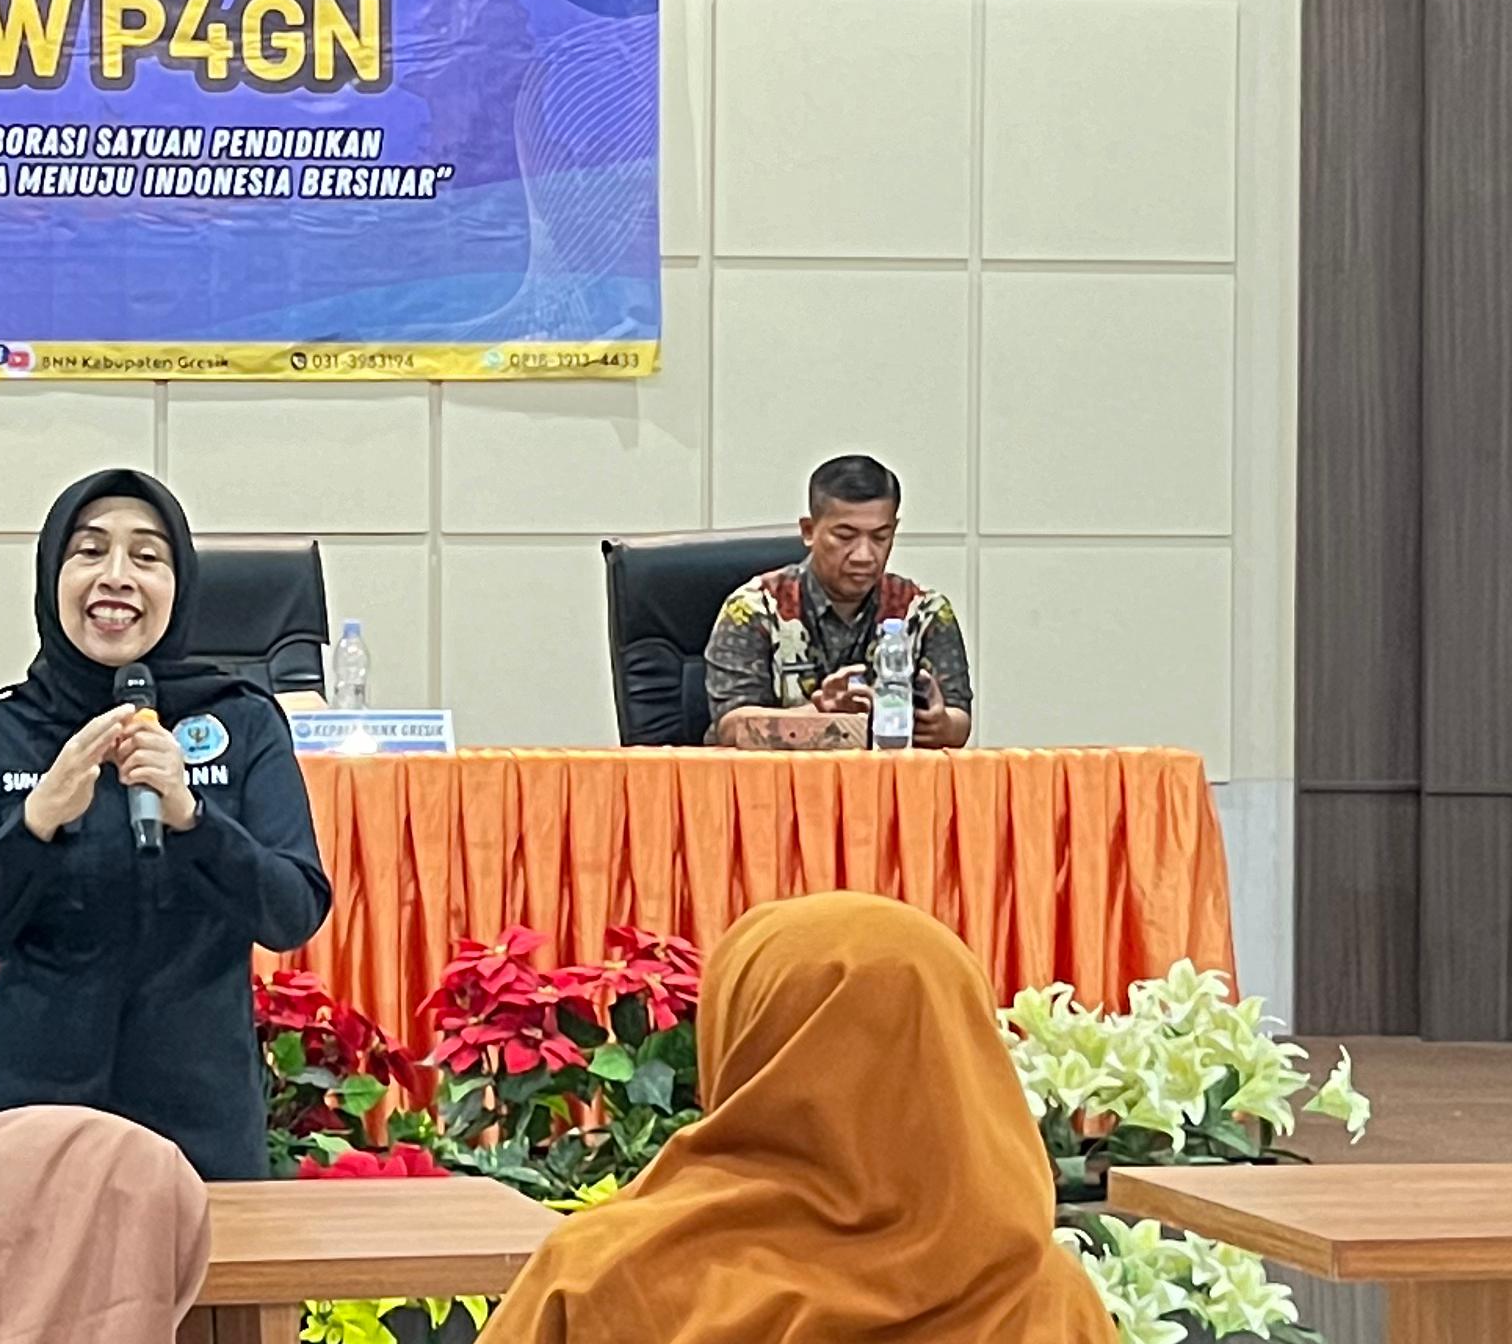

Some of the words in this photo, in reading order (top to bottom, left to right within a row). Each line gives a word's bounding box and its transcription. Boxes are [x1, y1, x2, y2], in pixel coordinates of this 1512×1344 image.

[95, 128, 203, 158] SATUAN
[211, 130, 382, 159] PENDIDIKAN
[16, 166, 136, 196] MENUJU
[143, 167, 290, 196] INDONESIA
[42, 357, 77, 369] BNN
